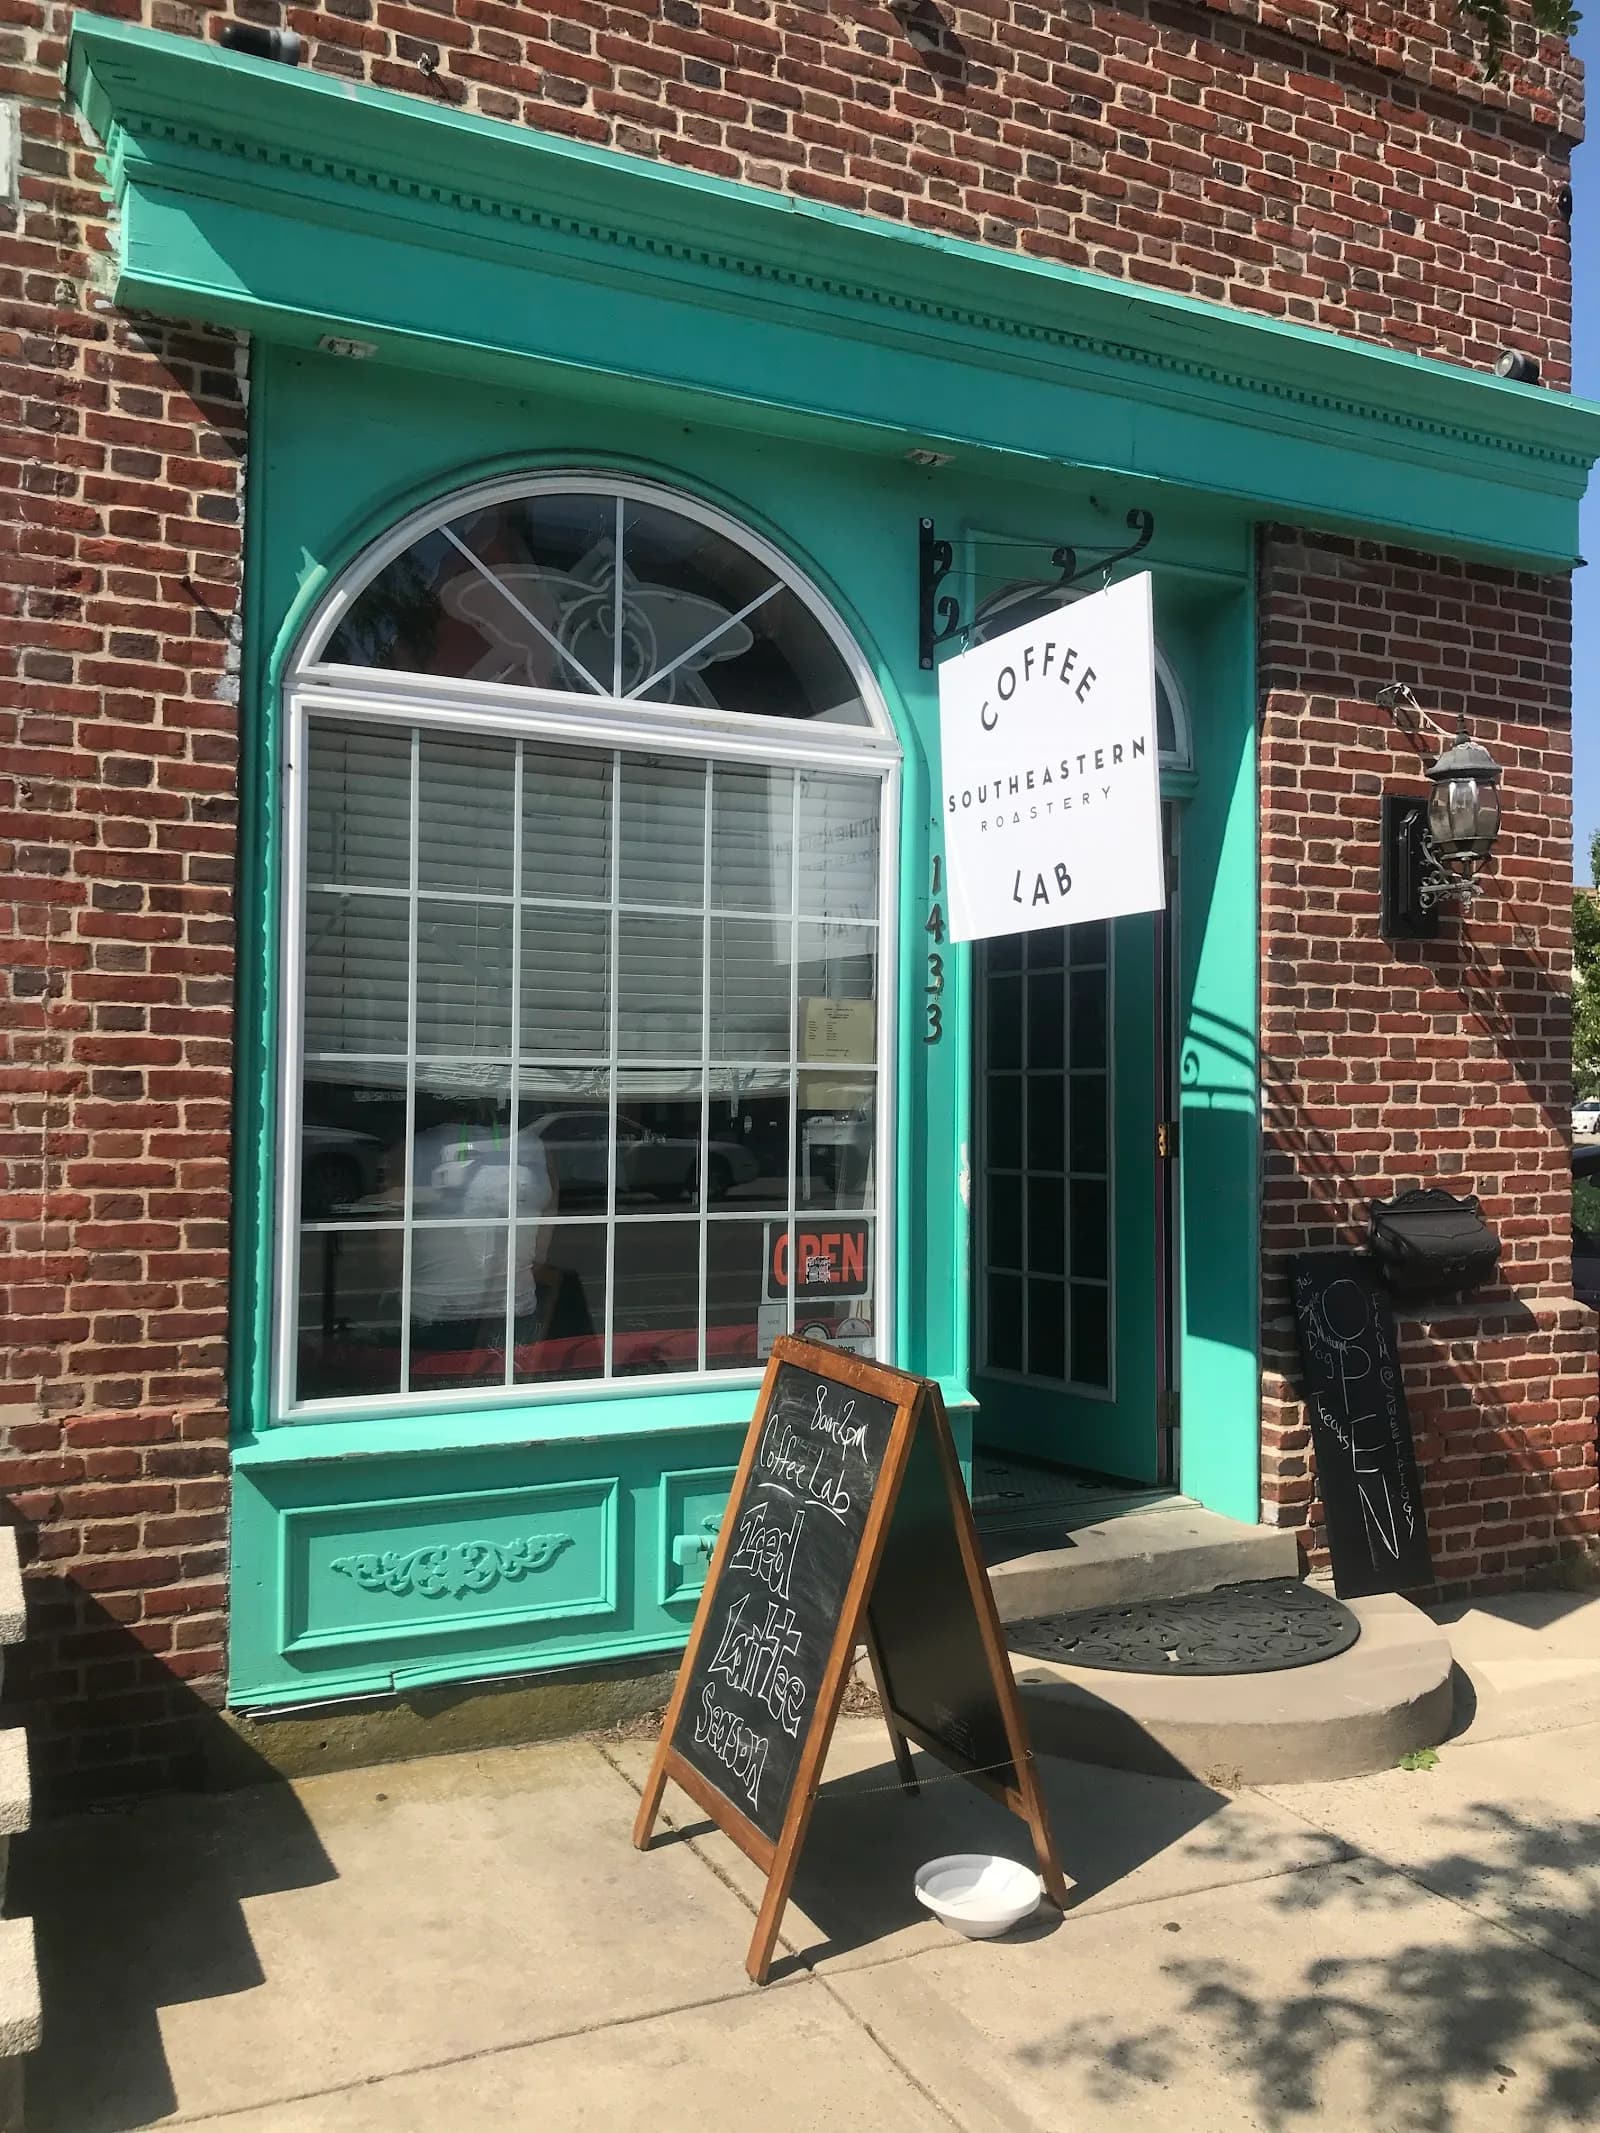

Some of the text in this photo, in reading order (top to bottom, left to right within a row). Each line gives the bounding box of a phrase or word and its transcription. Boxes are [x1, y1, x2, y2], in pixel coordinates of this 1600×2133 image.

[980, 642, 1097, 731] COFFEE
[948, 736, 1146, 813] SOUTHEASTERN
[980, 785, 1112, 832] ROASTERY
[1012, 861, 1073, 907] LAB
[923, 854, 946, 1046] 1433
[773, 1232, 865, 1286] OPEN
[1306, 1330, 1335, 1380] Dog
[1311, 1390, 1350, 1451] Treats
[1321, 1279, 1401, 1571] OPEN
[760, 1414, 850, 1514] Coffee Lab
[694, 1681, 769, 1812] Season
